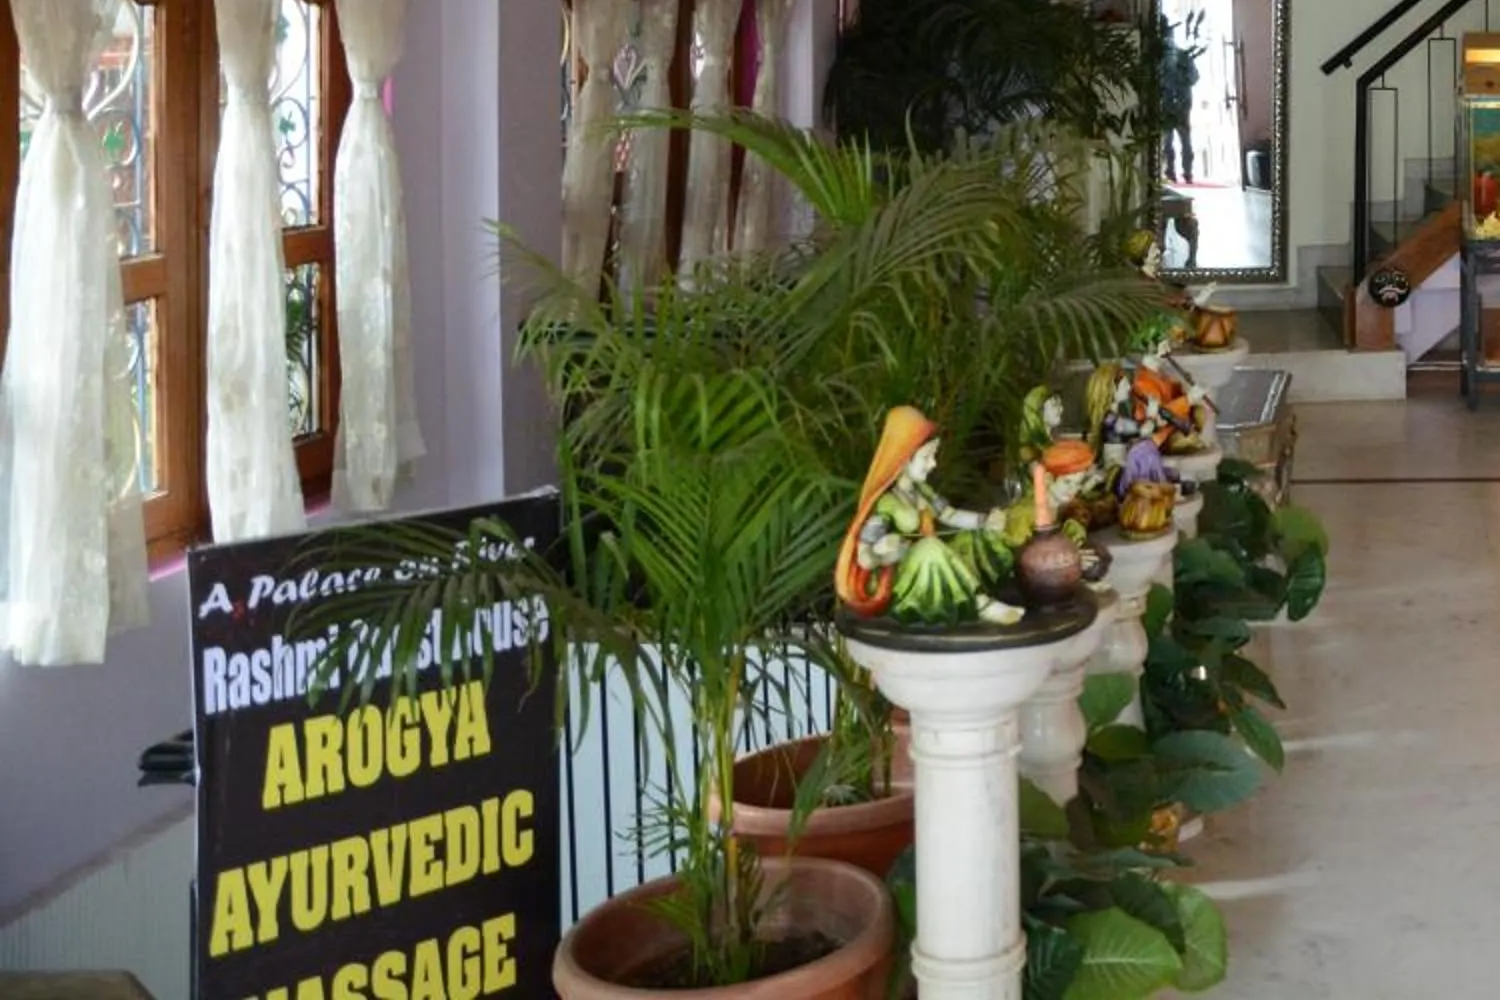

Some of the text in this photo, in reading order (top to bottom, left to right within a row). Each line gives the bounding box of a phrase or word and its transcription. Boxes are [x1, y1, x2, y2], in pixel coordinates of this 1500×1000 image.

[199, 582, 234, 618] A
[347, 608, 443, 685] Gust
[451, 593, 549, 661] ouse
[261, 680, 492, 810] AROGYA
[209, 789, 535, 958] AYURVEDIC
[242, 912, 517, 1000] SAGE
